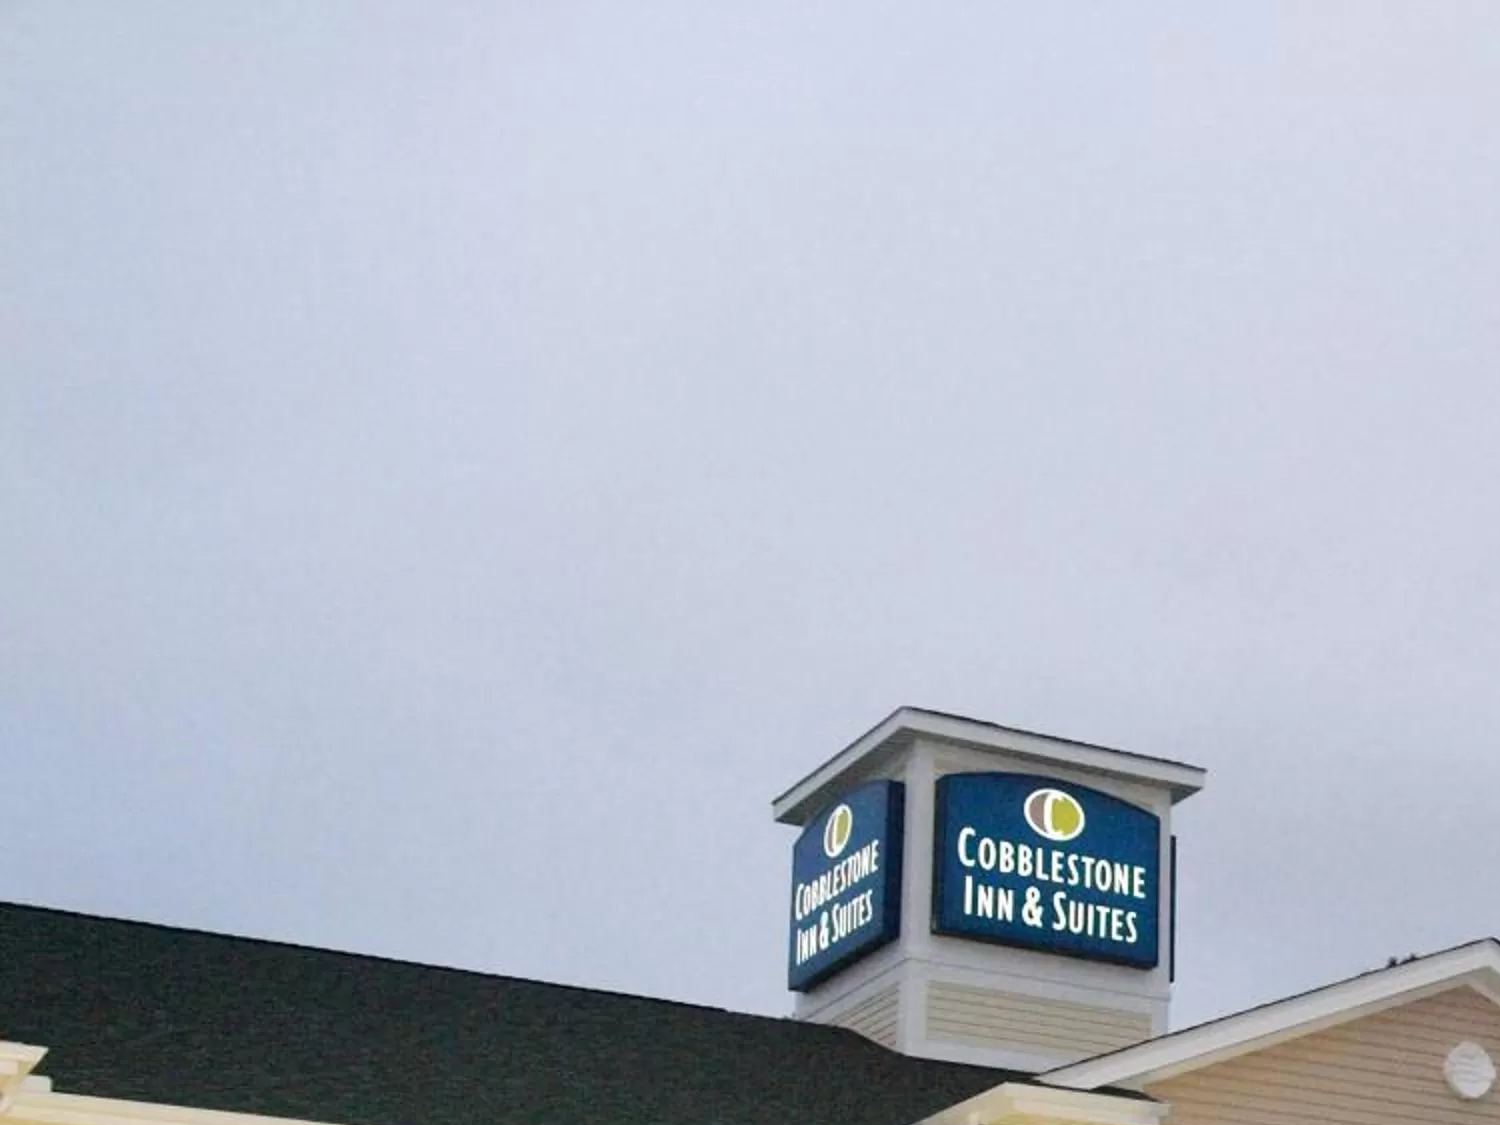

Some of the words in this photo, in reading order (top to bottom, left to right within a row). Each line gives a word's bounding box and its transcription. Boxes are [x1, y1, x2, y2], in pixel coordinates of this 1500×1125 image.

[795, 840, 879, 921] COBBLESTONE
[958, 827, 1146, 898] COBBLESTONE
[796, 924, 817, 965] INN
[819, 911, 830, 951] &
[831, 889, 873, 943] SUITES
[964, 875, 1014, 922] INN
[1022, 886, 1044, 928] &
[1052, 891, 1137, 943] SUITES
